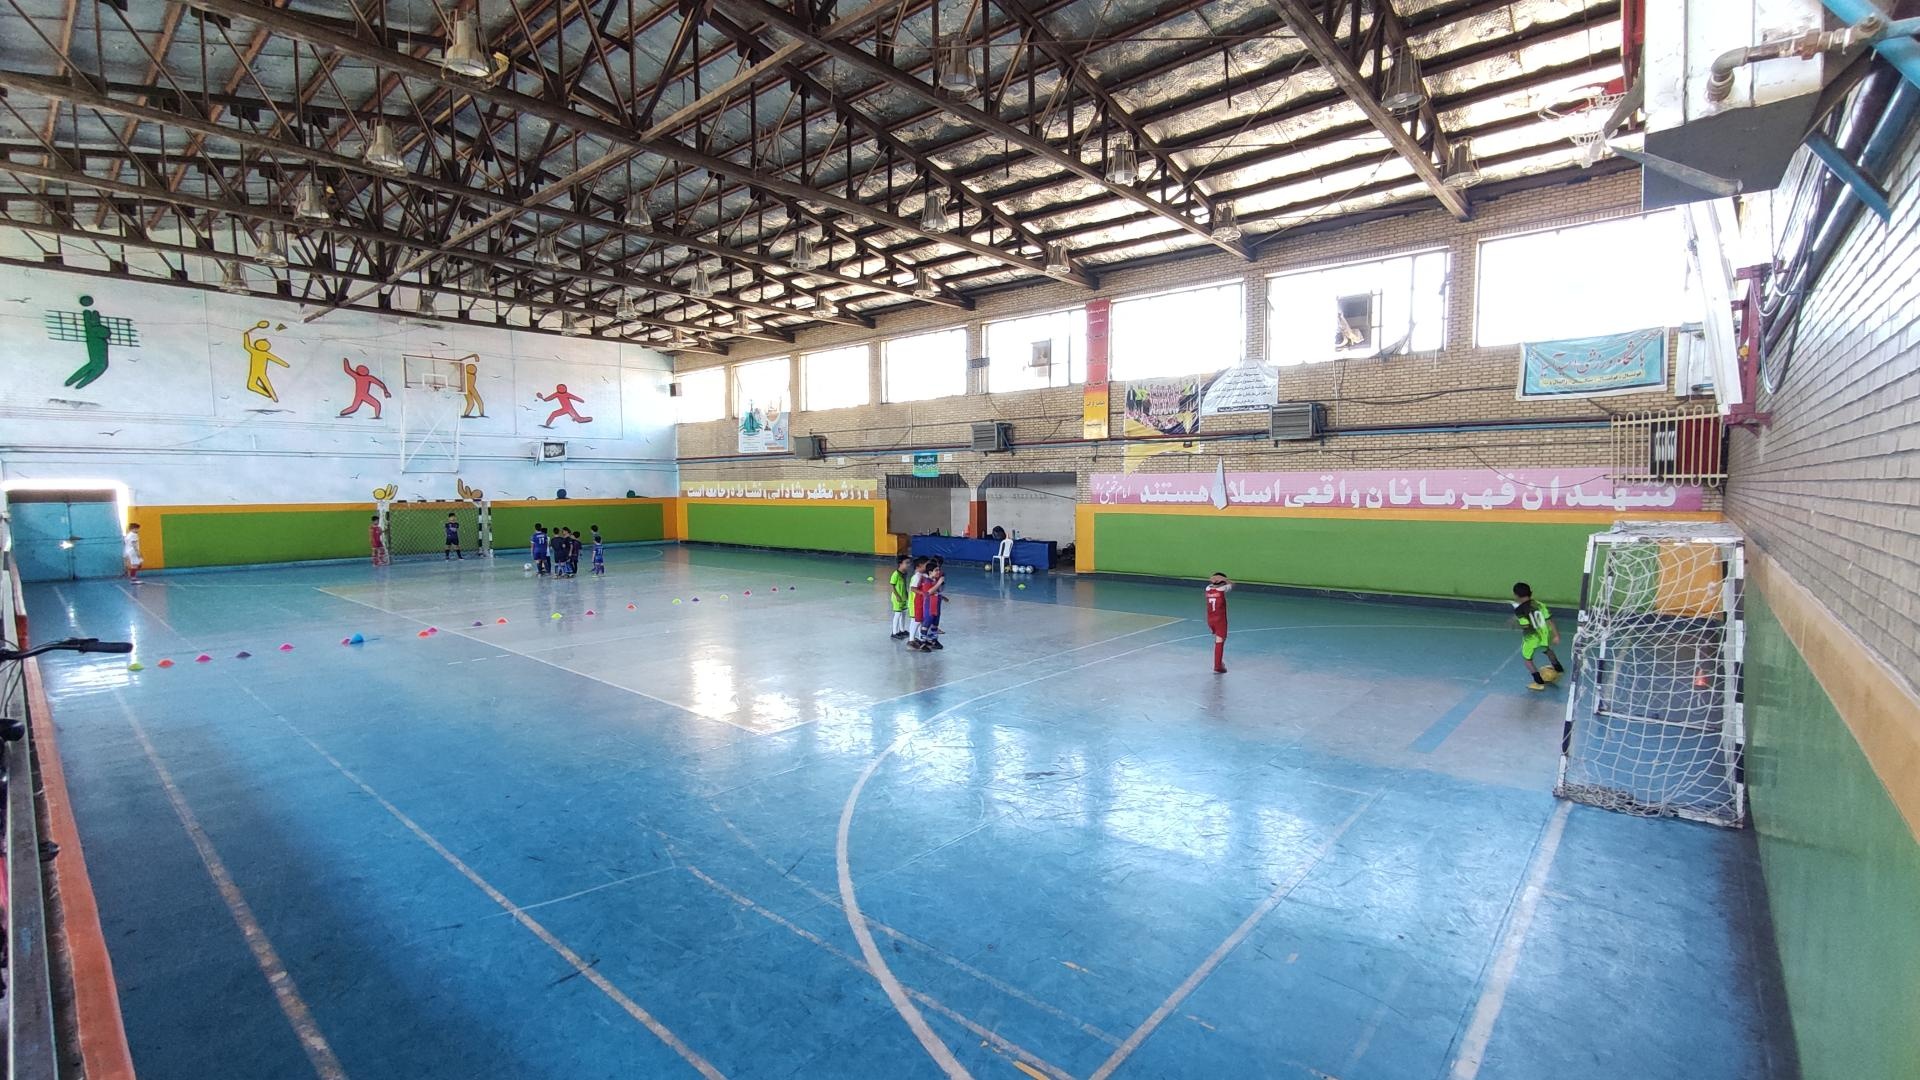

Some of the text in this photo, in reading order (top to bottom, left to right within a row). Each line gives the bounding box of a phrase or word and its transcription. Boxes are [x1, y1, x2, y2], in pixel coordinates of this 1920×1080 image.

[1139, 481, 1210, 504] هستند
[1228, 478, 1281, 504] اسلا
[1284, 475, 1361, 508] واقعی
[1366, 473, 1516, 510] قهرمانان
[1208, 598, 1216, 612] 7
[1528, 610, 1546, 629] 10
